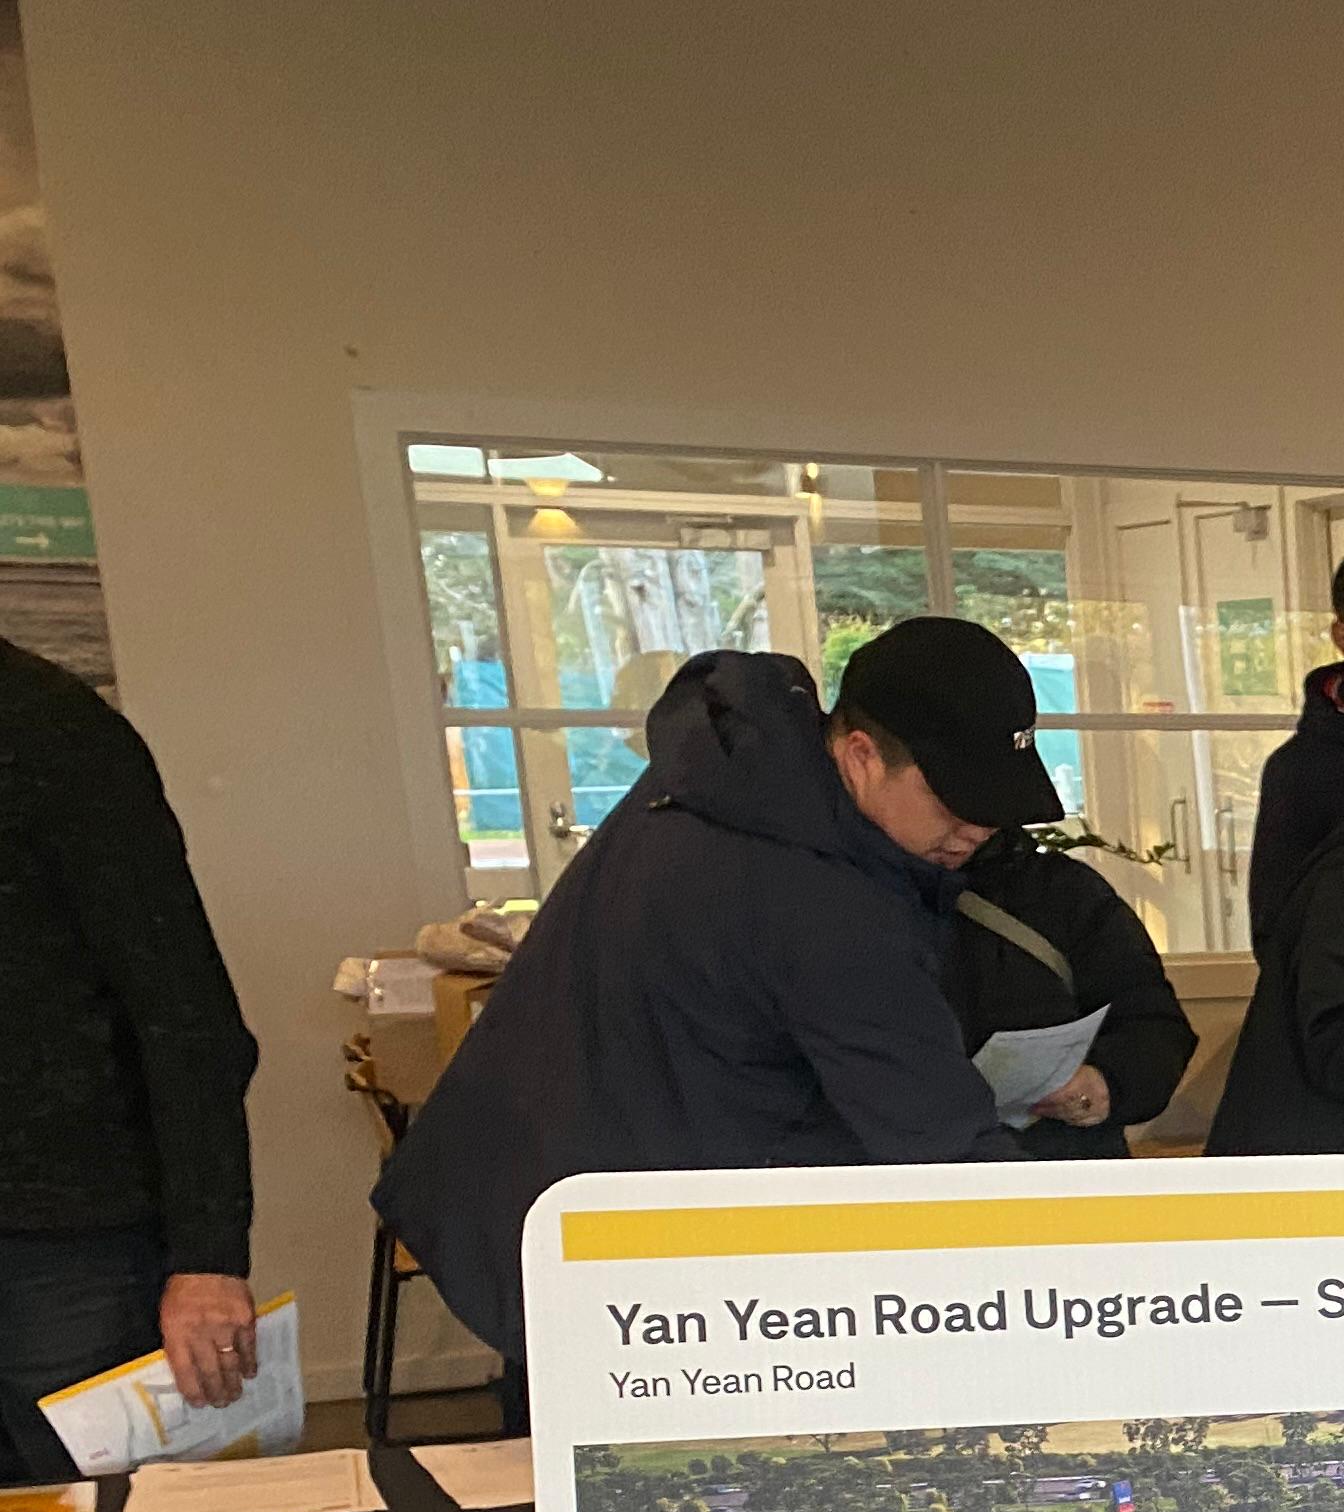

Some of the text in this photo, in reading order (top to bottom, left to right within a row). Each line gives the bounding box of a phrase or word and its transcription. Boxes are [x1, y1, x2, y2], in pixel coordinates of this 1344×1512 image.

[606, 1303, 707, 1346] Yan
[725, 1299, 857, 1341] Yean
[874, 1290, 1007, 1336] Road
[1024, 1283, 1243, 1340] Upgrade
[610, 1362, 856, 1398] Yan Yean Road
